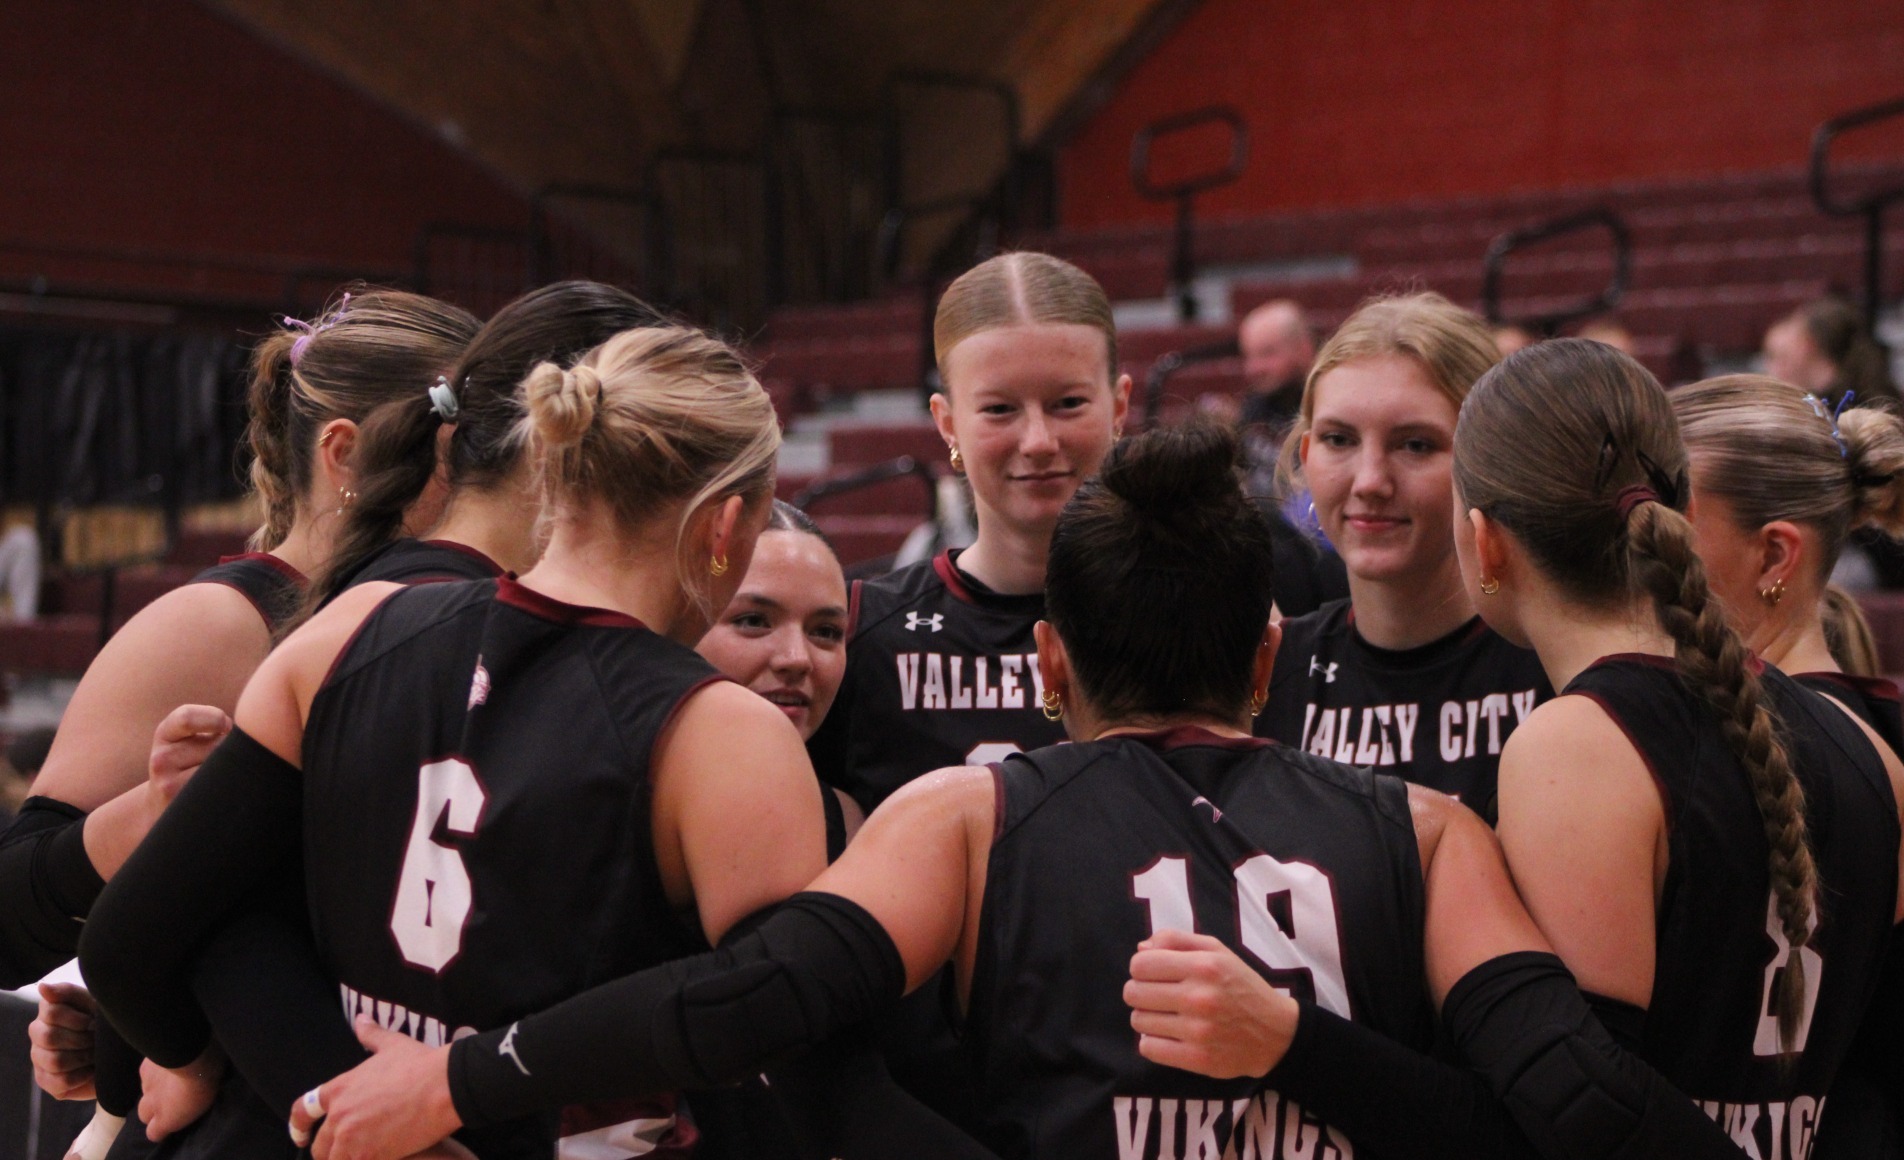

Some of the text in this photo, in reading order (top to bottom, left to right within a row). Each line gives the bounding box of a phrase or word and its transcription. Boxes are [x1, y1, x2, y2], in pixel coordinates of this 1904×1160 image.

[896, 652, 1044, 711] VALLEY
[1439, 689, 1536, 763] CITY
[390, 757, 486, 975] 6
